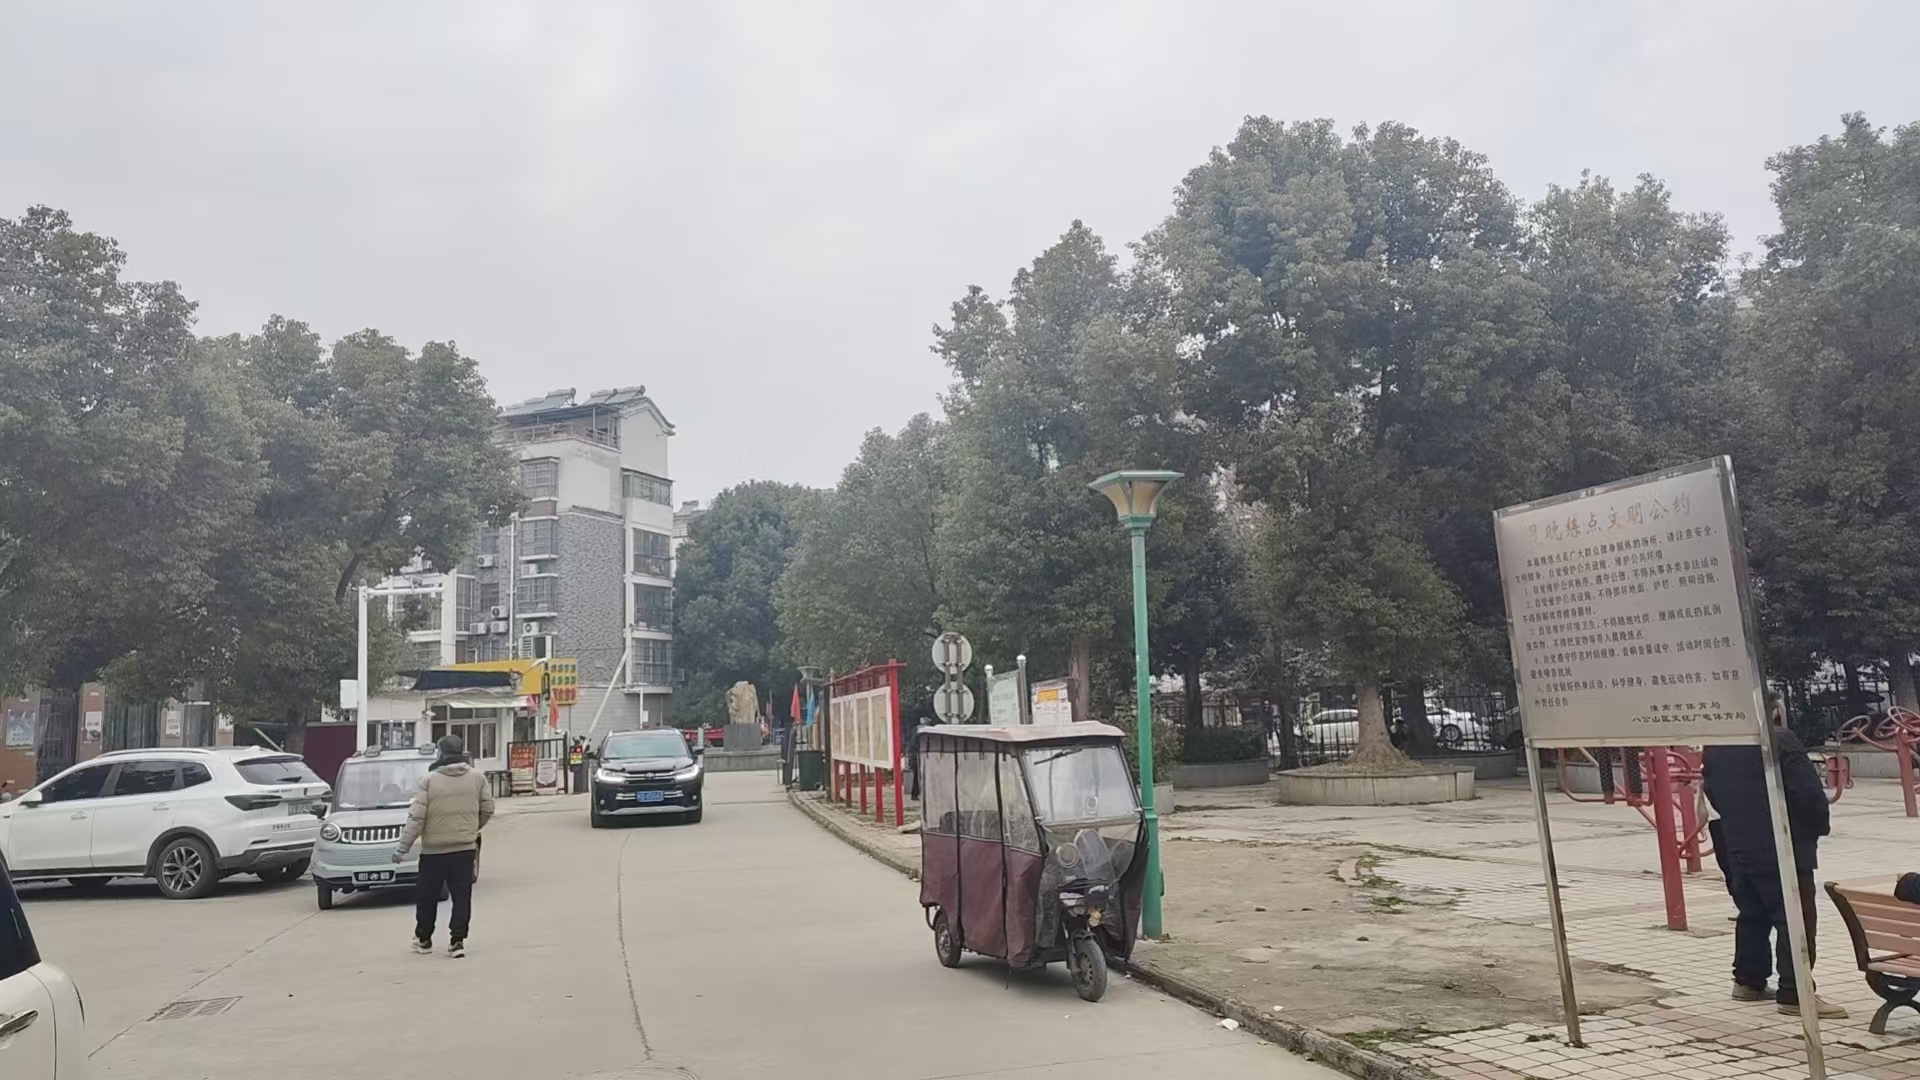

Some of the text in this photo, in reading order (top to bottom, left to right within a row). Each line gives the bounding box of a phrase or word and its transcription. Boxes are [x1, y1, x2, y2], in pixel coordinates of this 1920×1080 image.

[1648, 700, 1721, 712] 淮南市体育局
[1631, 710, 1746, 724] 八公山区文化广电体育局
